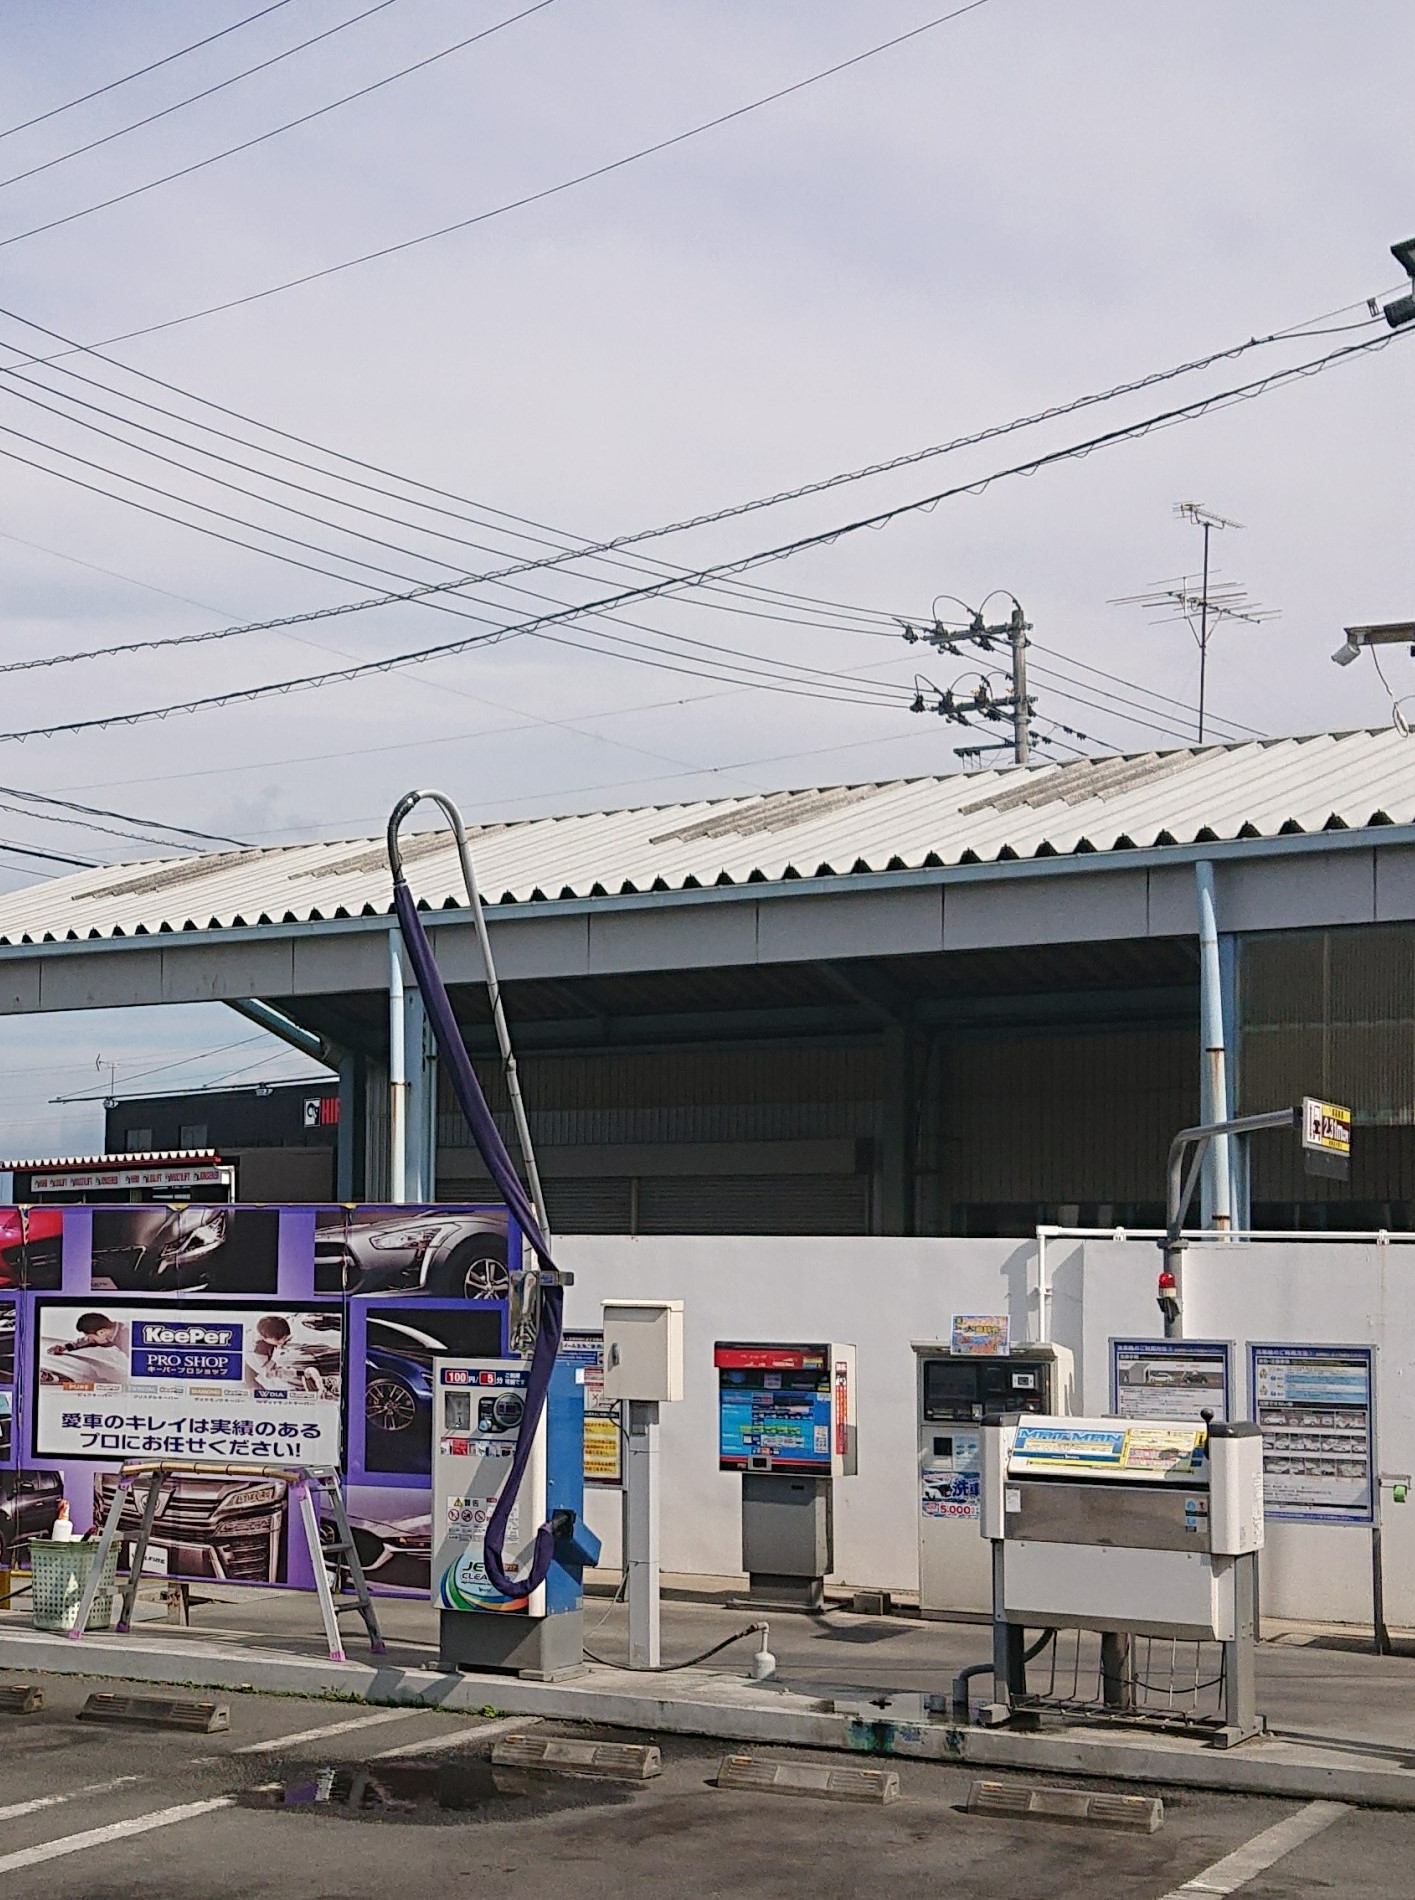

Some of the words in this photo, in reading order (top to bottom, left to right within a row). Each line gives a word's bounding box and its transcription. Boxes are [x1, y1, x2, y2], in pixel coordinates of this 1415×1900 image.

[145, 1326, 231, 1345] KeePer
[147, 1354, 181, 1366] PRO
[184, 1356, 229, 1368] SHOP
[61, 1412, 322, 1439] 愛車のキレイは実績のある
[462, 1561, 485, 1573] JE
